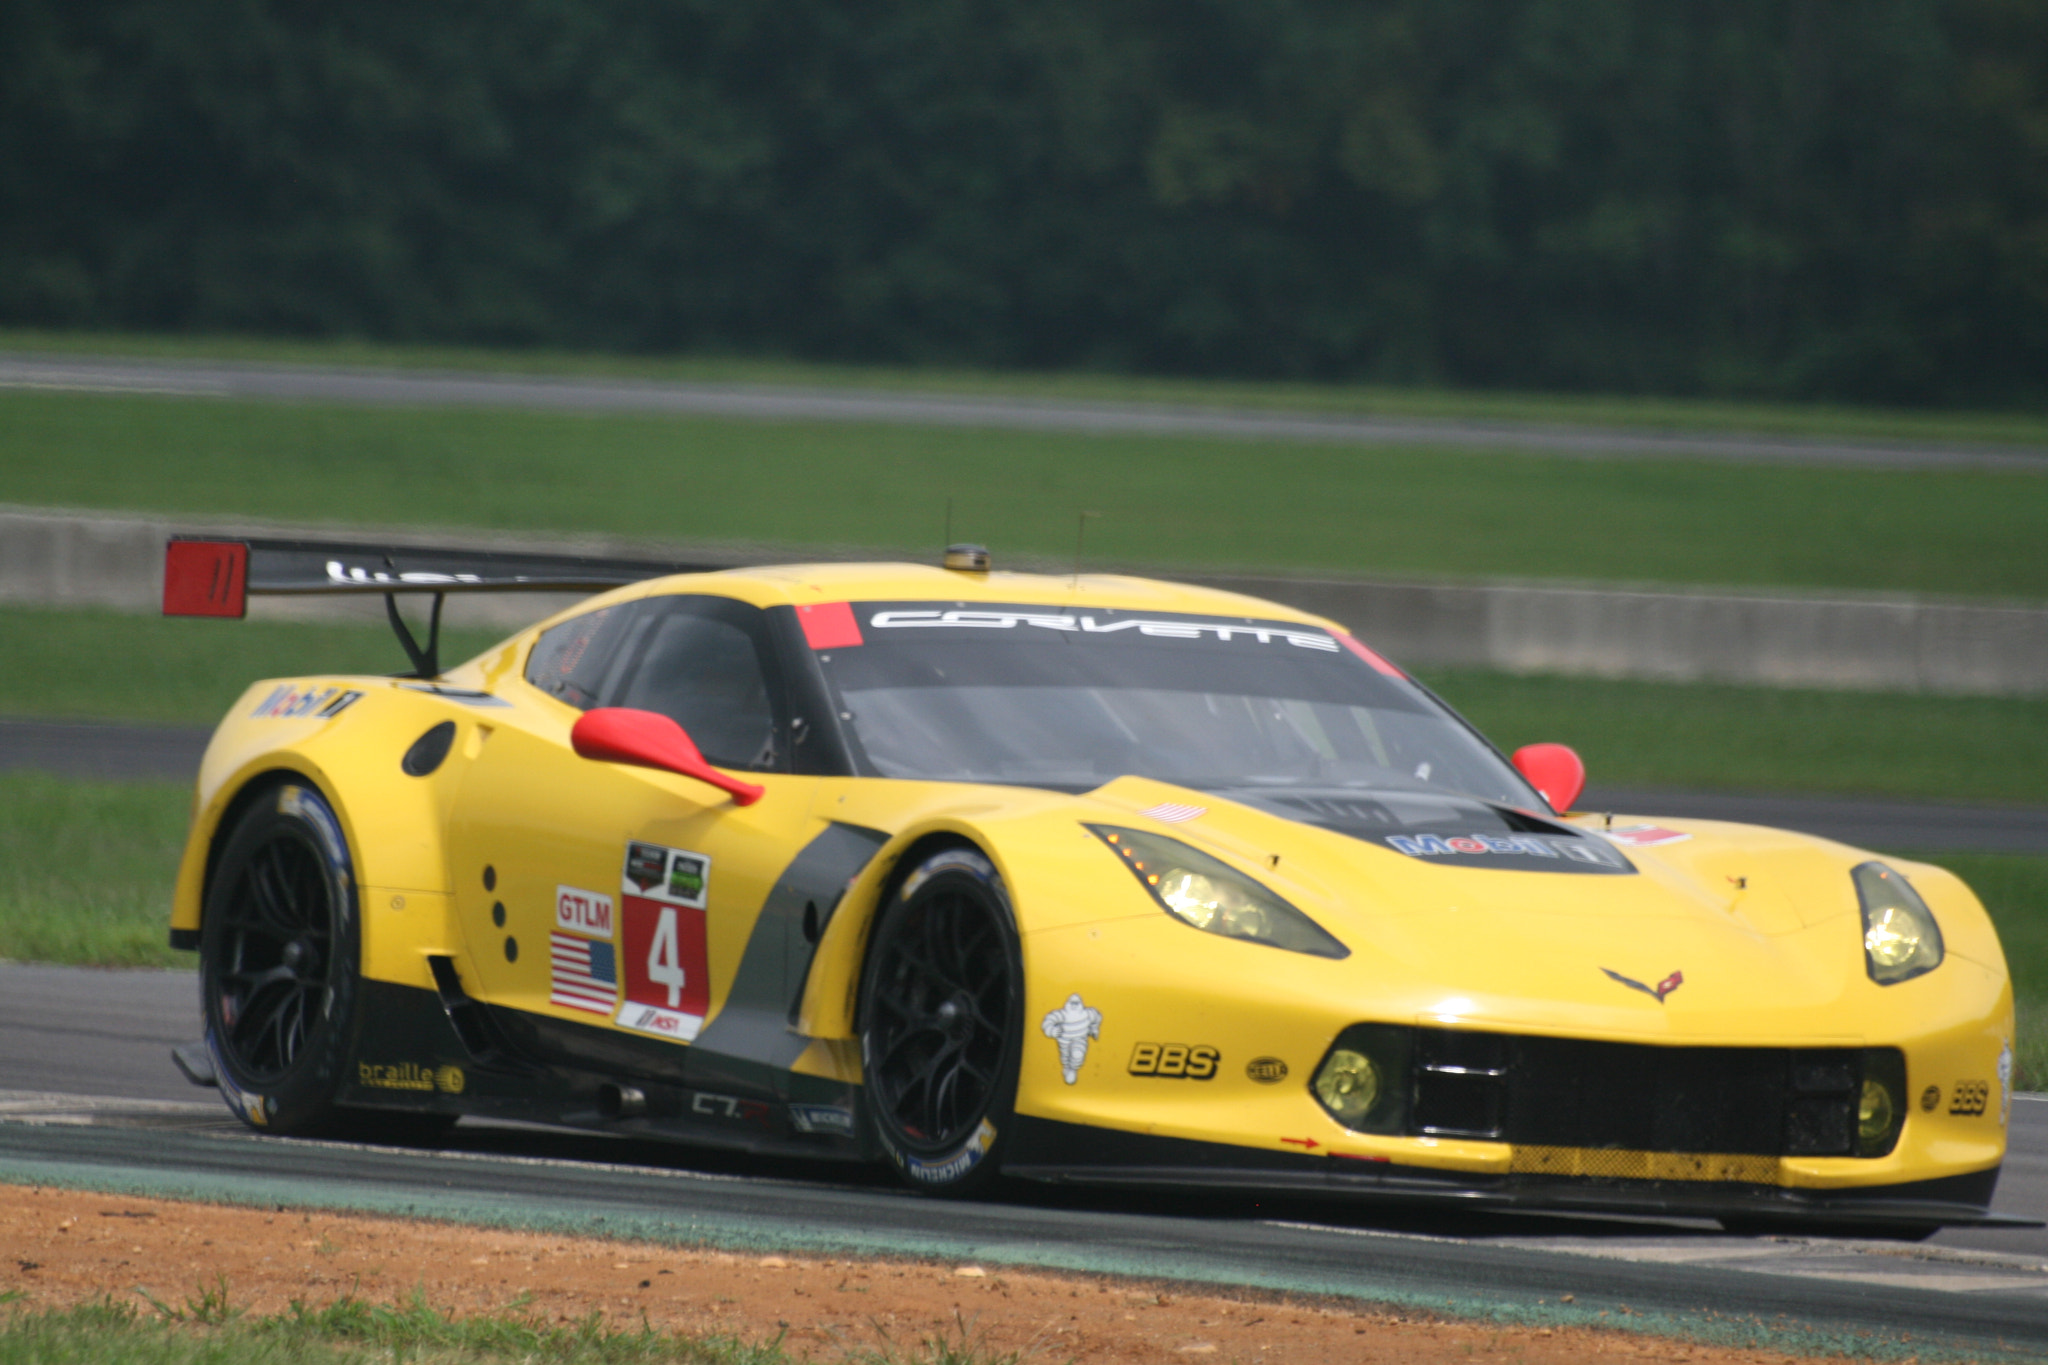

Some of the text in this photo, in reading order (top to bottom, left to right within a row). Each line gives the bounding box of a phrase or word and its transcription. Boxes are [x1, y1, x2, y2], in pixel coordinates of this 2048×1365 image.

[871, 611, 1340, 653] CORVETTE
[1386, 834, 1560, 857] Mobil
[559, 894, 611, 930] GTLM
[648, 907, 685, 1008] 4
[359, 1061, 433, 1081] braille
[1127, 1042, 1221, 1080] BBS
[1949, 1080, 1989, 1116] BBS
